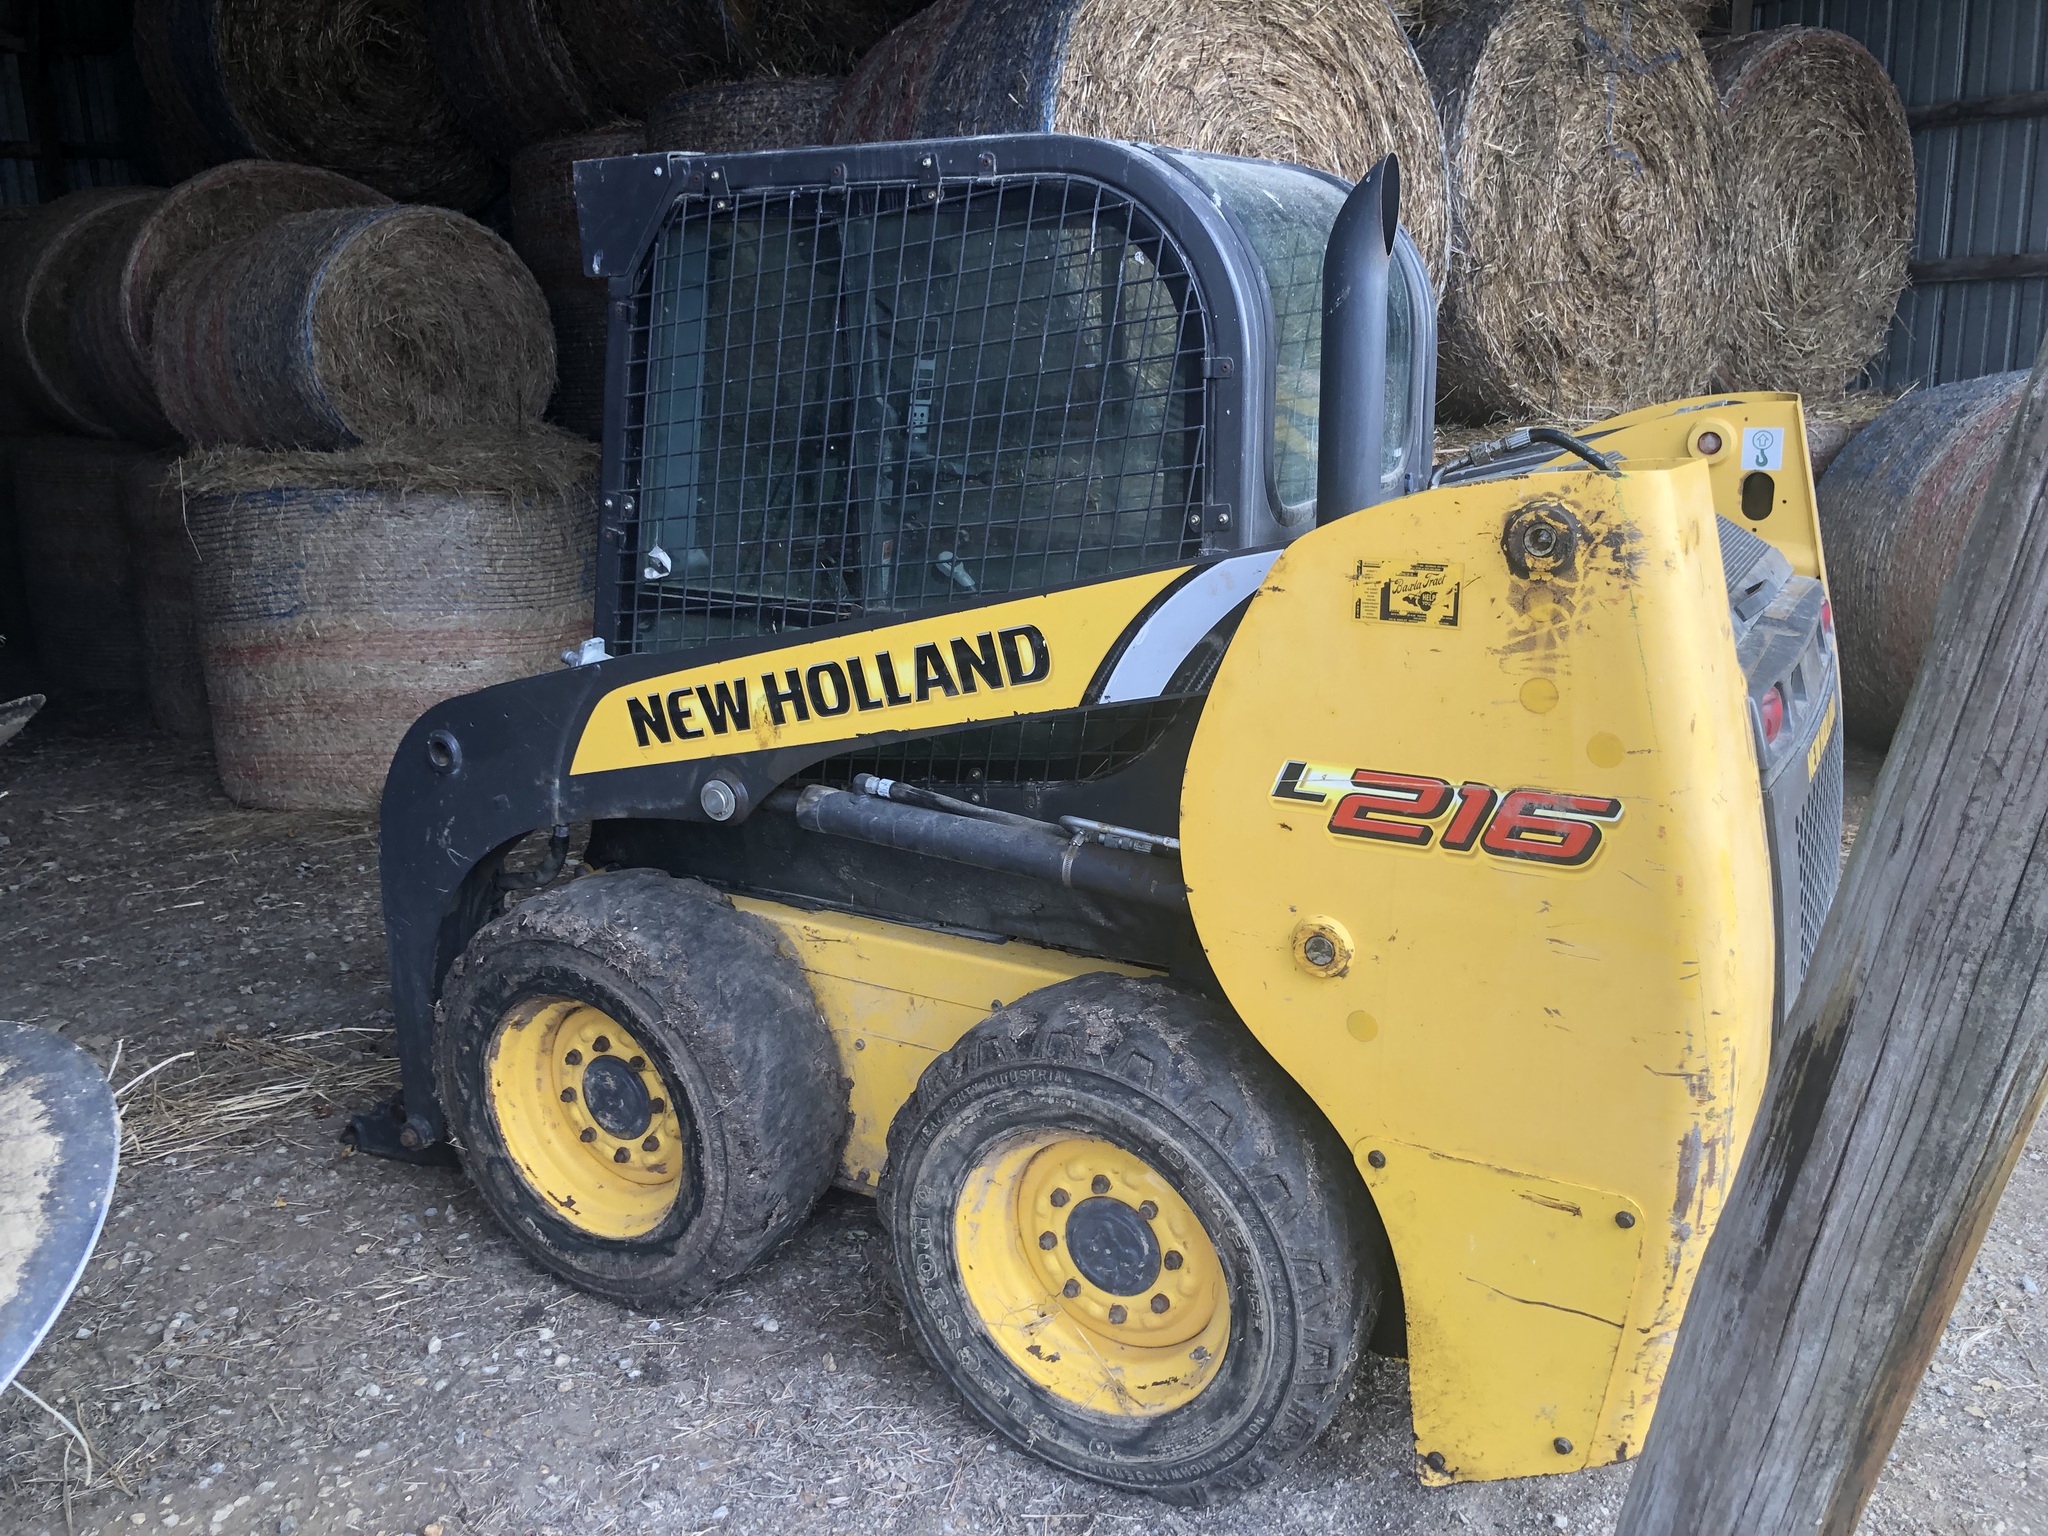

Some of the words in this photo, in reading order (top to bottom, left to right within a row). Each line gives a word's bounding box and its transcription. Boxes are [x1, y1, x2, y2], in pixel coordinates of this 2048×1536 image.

[1422, 592, 1436, 602] HELP
[626, 676, 751, 748] NEW
[760, 623, 1051, 726] HOLLAND
